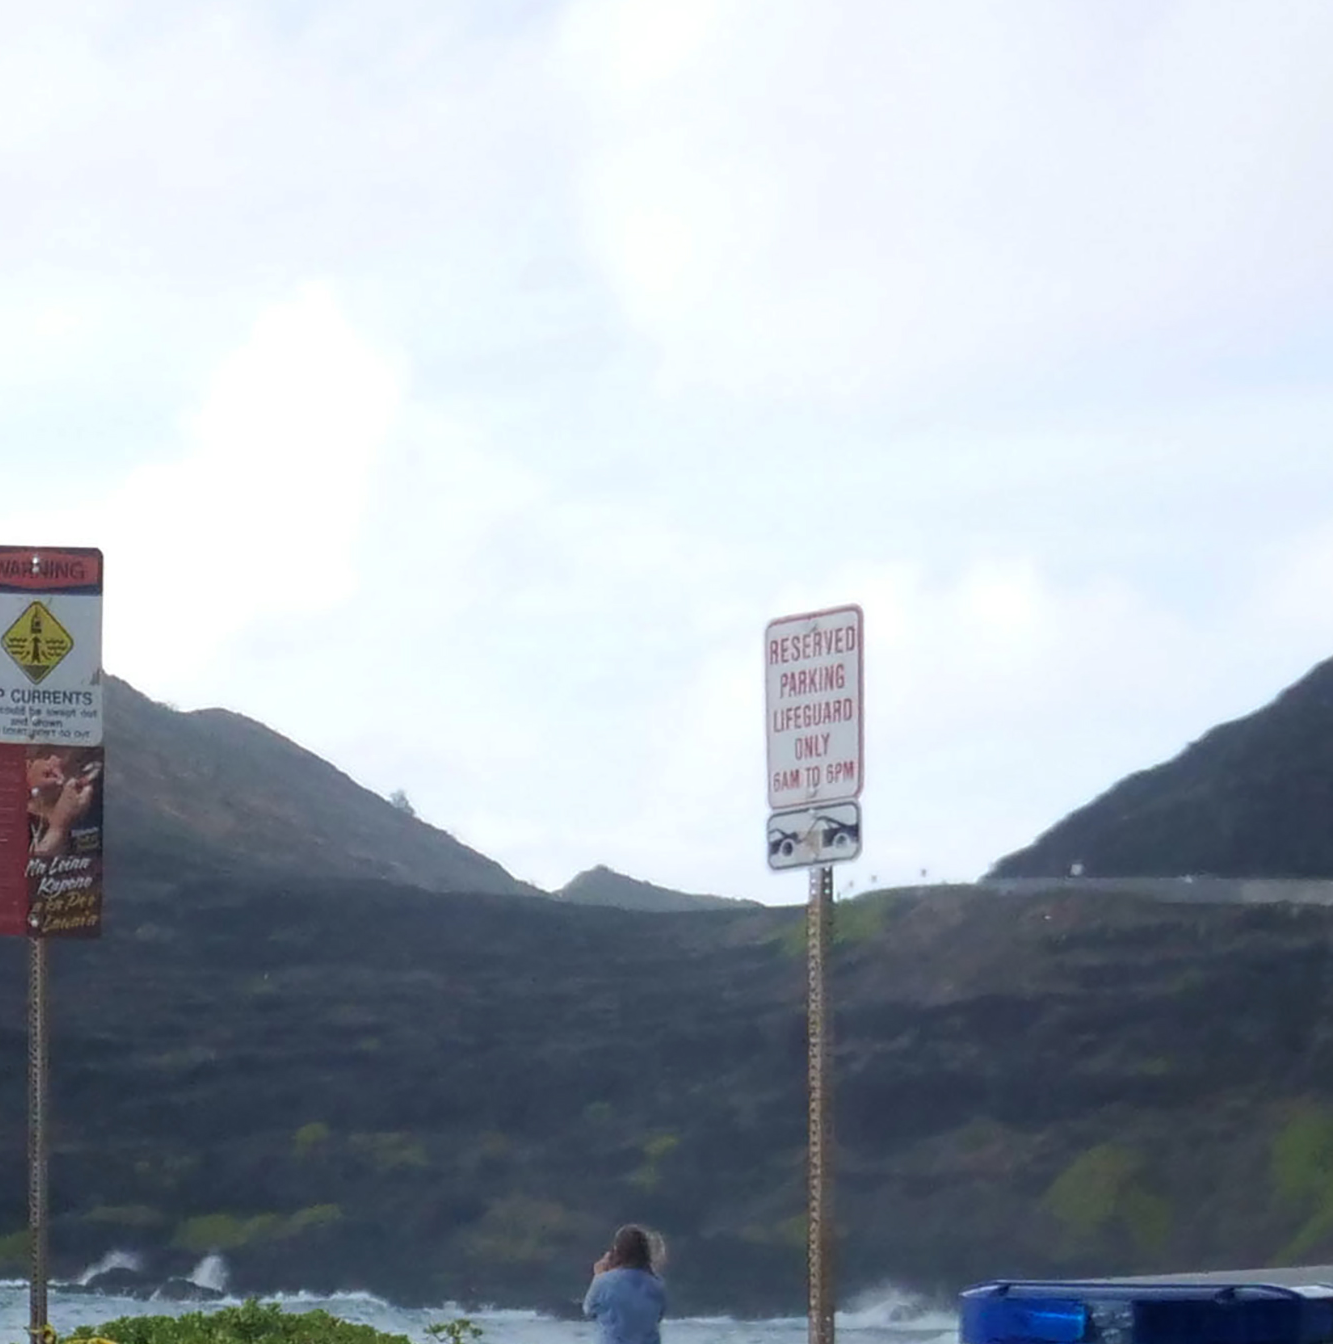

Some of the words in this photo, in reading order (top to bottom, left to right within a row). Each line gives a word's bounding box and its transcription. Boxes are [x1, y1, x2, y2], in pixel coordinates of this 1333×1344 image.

[770, 625, 856, 665] RESERVED
[11, 689, 93, 706] CURRENTS
[780, 663, 845, 699] PARKING
[773, 698, 853, 733] LIFEGUARD
[794, 733, 831, 761] ONLY
[773, 769, 800, 792] 6AM
[804, 765, 820, 788] TO
[826, 760, 855, 784] 6PM
